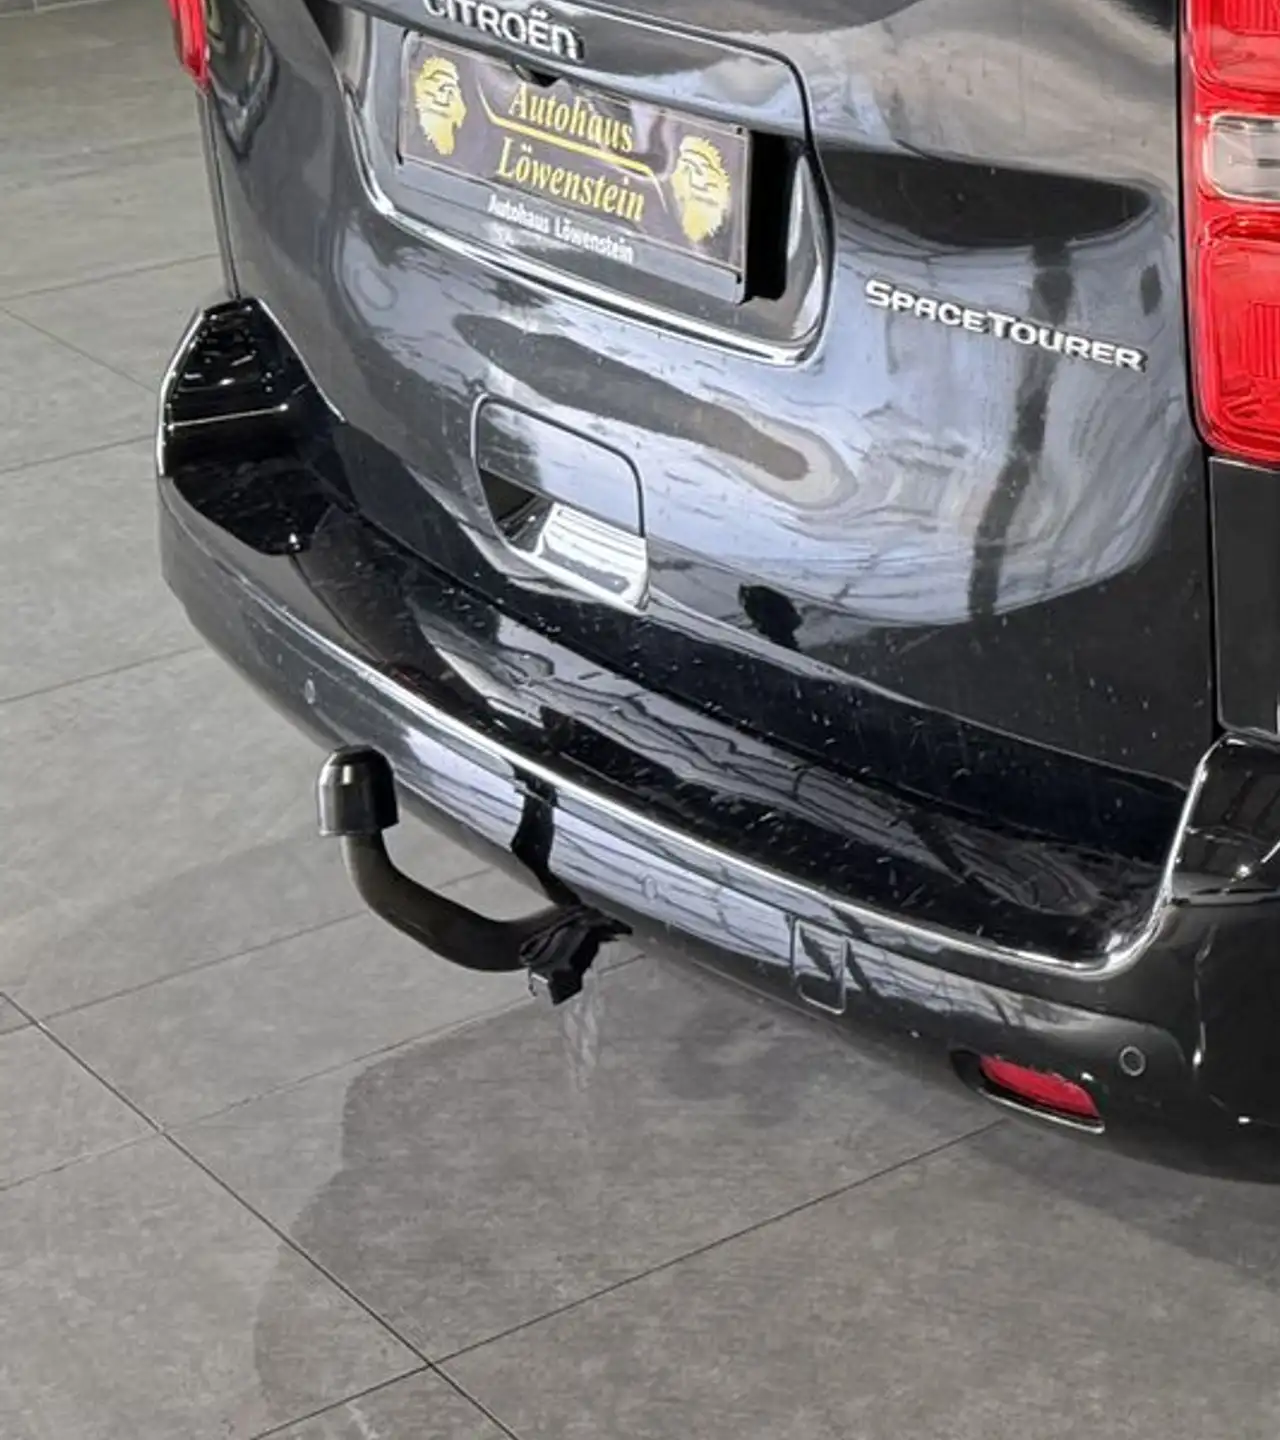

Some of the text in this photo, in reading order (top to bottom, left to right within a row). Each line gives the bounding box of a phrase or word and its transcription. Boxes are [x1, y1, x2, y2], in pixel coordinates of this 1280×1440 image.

[507, 82, 634, 152] Autohaus
[495, 137, 645, 223] Löwenstein
[488, 193, 634, 265] Autohaus Löwenstein
